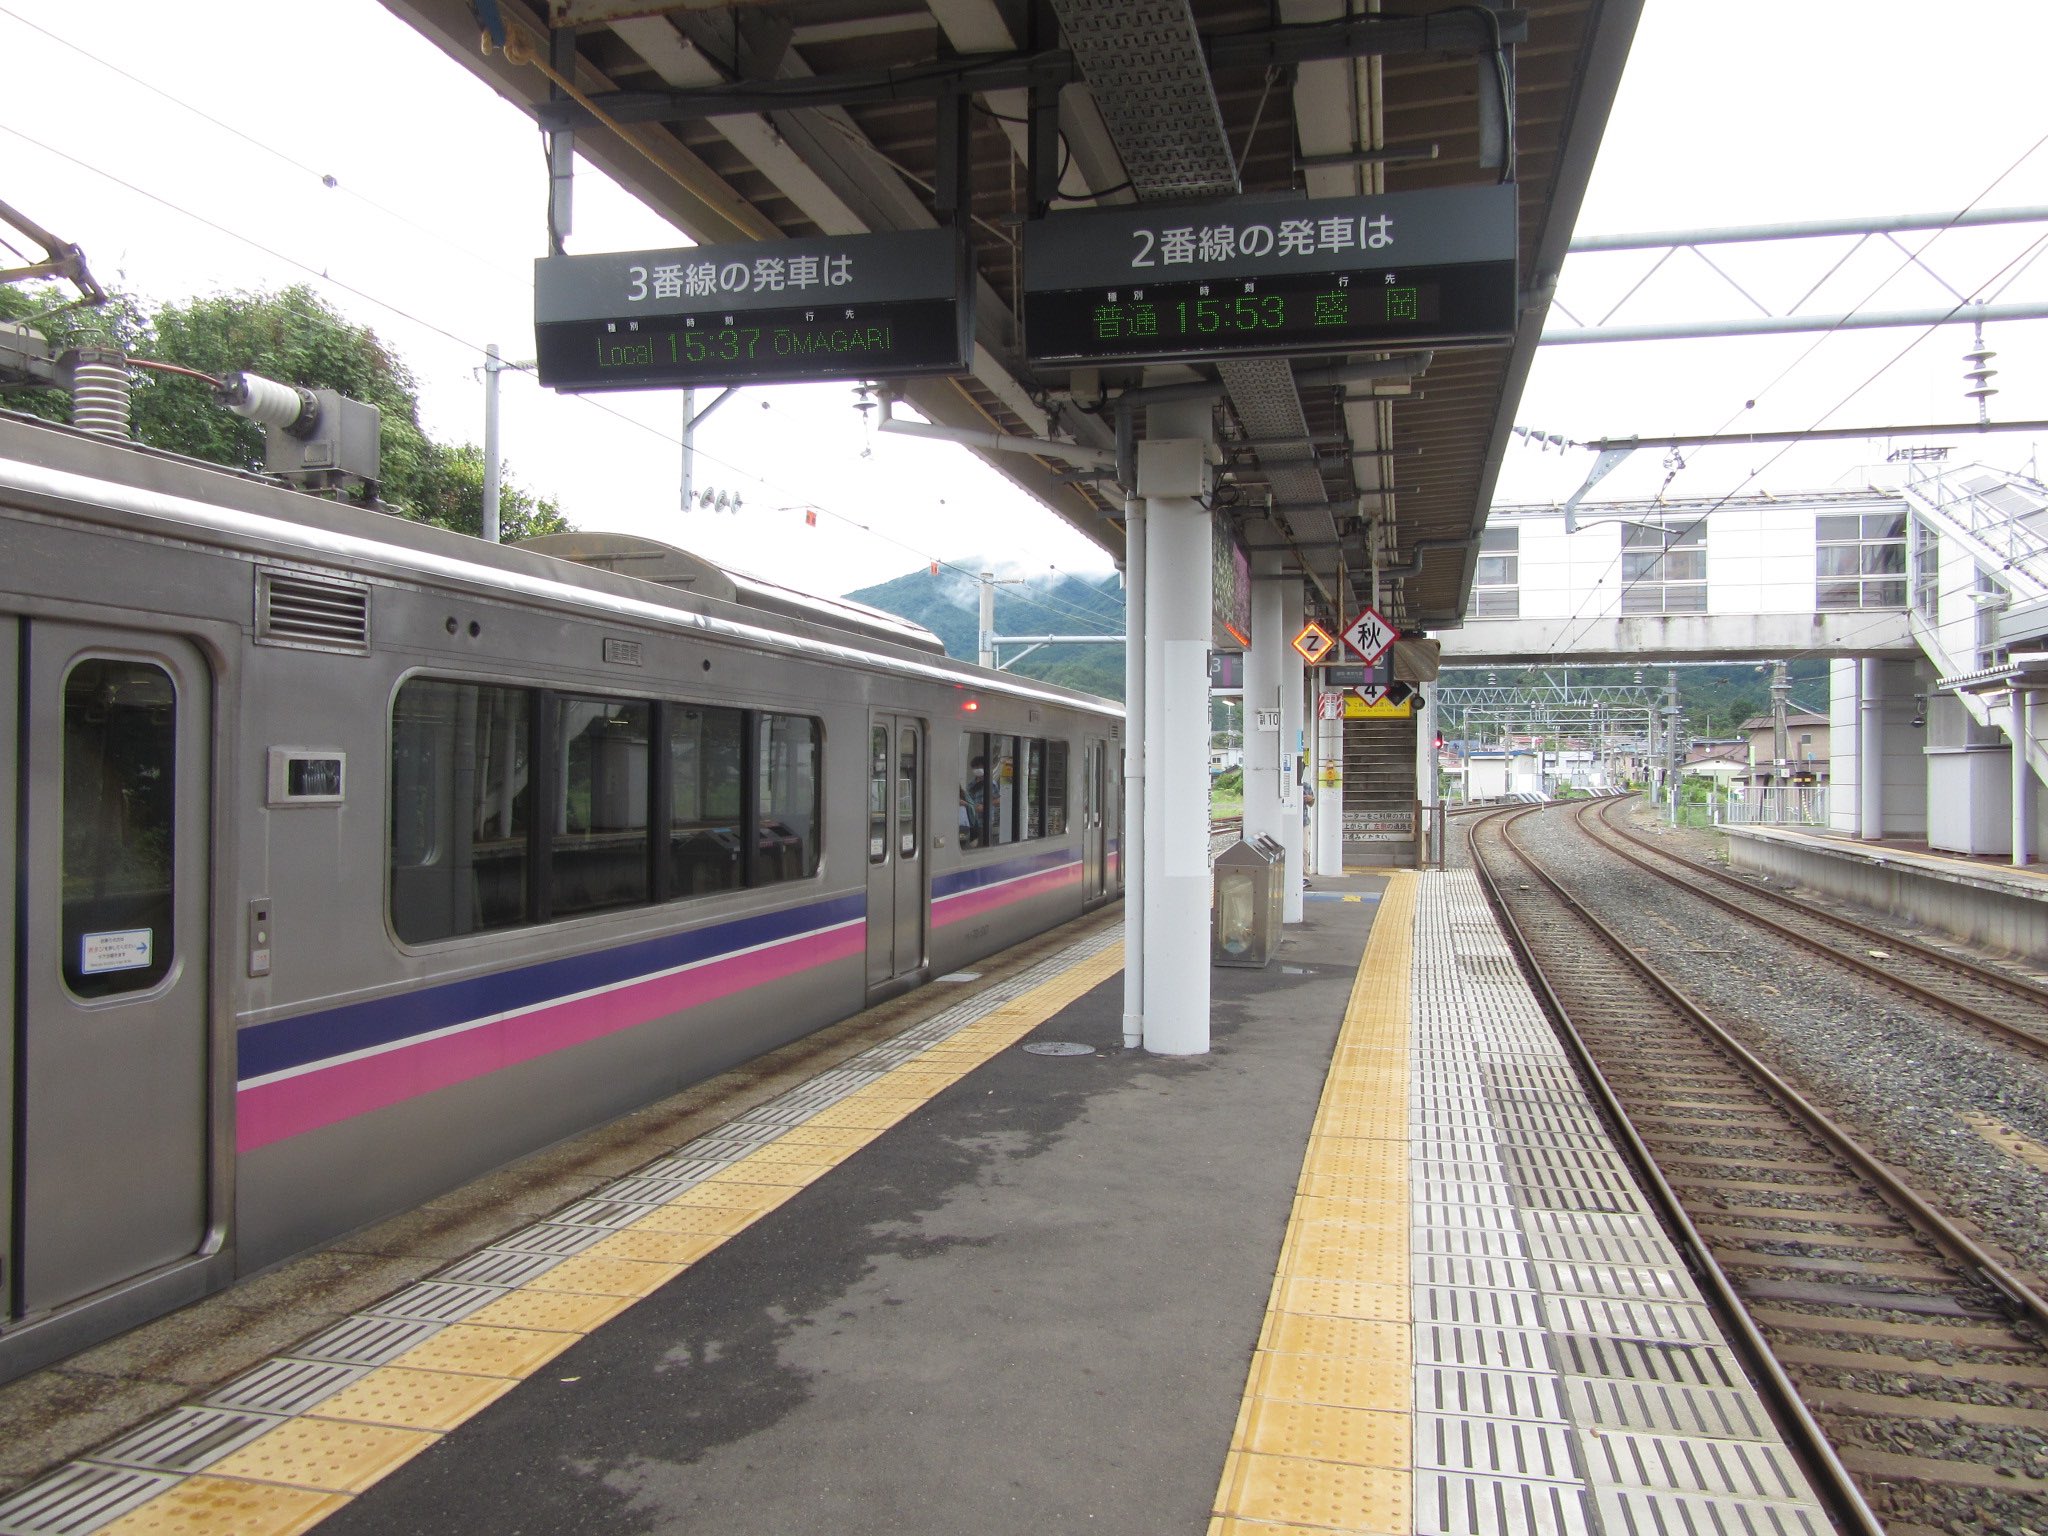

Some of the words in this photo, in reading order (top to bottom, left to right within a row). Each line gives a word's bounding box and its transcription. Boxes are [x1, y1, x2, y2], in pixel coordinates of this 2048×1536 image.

[1131, 214, 1394, 268] 2番線の発車は
[627, 254, 853, 302] 3番線の発車は
[1107, 289, 1143, 303] 種別
[1093, 303, 1157, 338] 普通
[1176, 295, 1286, 334] 15:53
[597, 337, 654, 367] Local
[667, 328, 760, 363] 15:37
[1306, 635, 1319, 652] Z
[1357, 622, 1382, 650] 秋
[1211, 657, 1221, 673] 3
[1364, 686, 1377, 699] 4
[1268, 713, 1279, 726] 10
